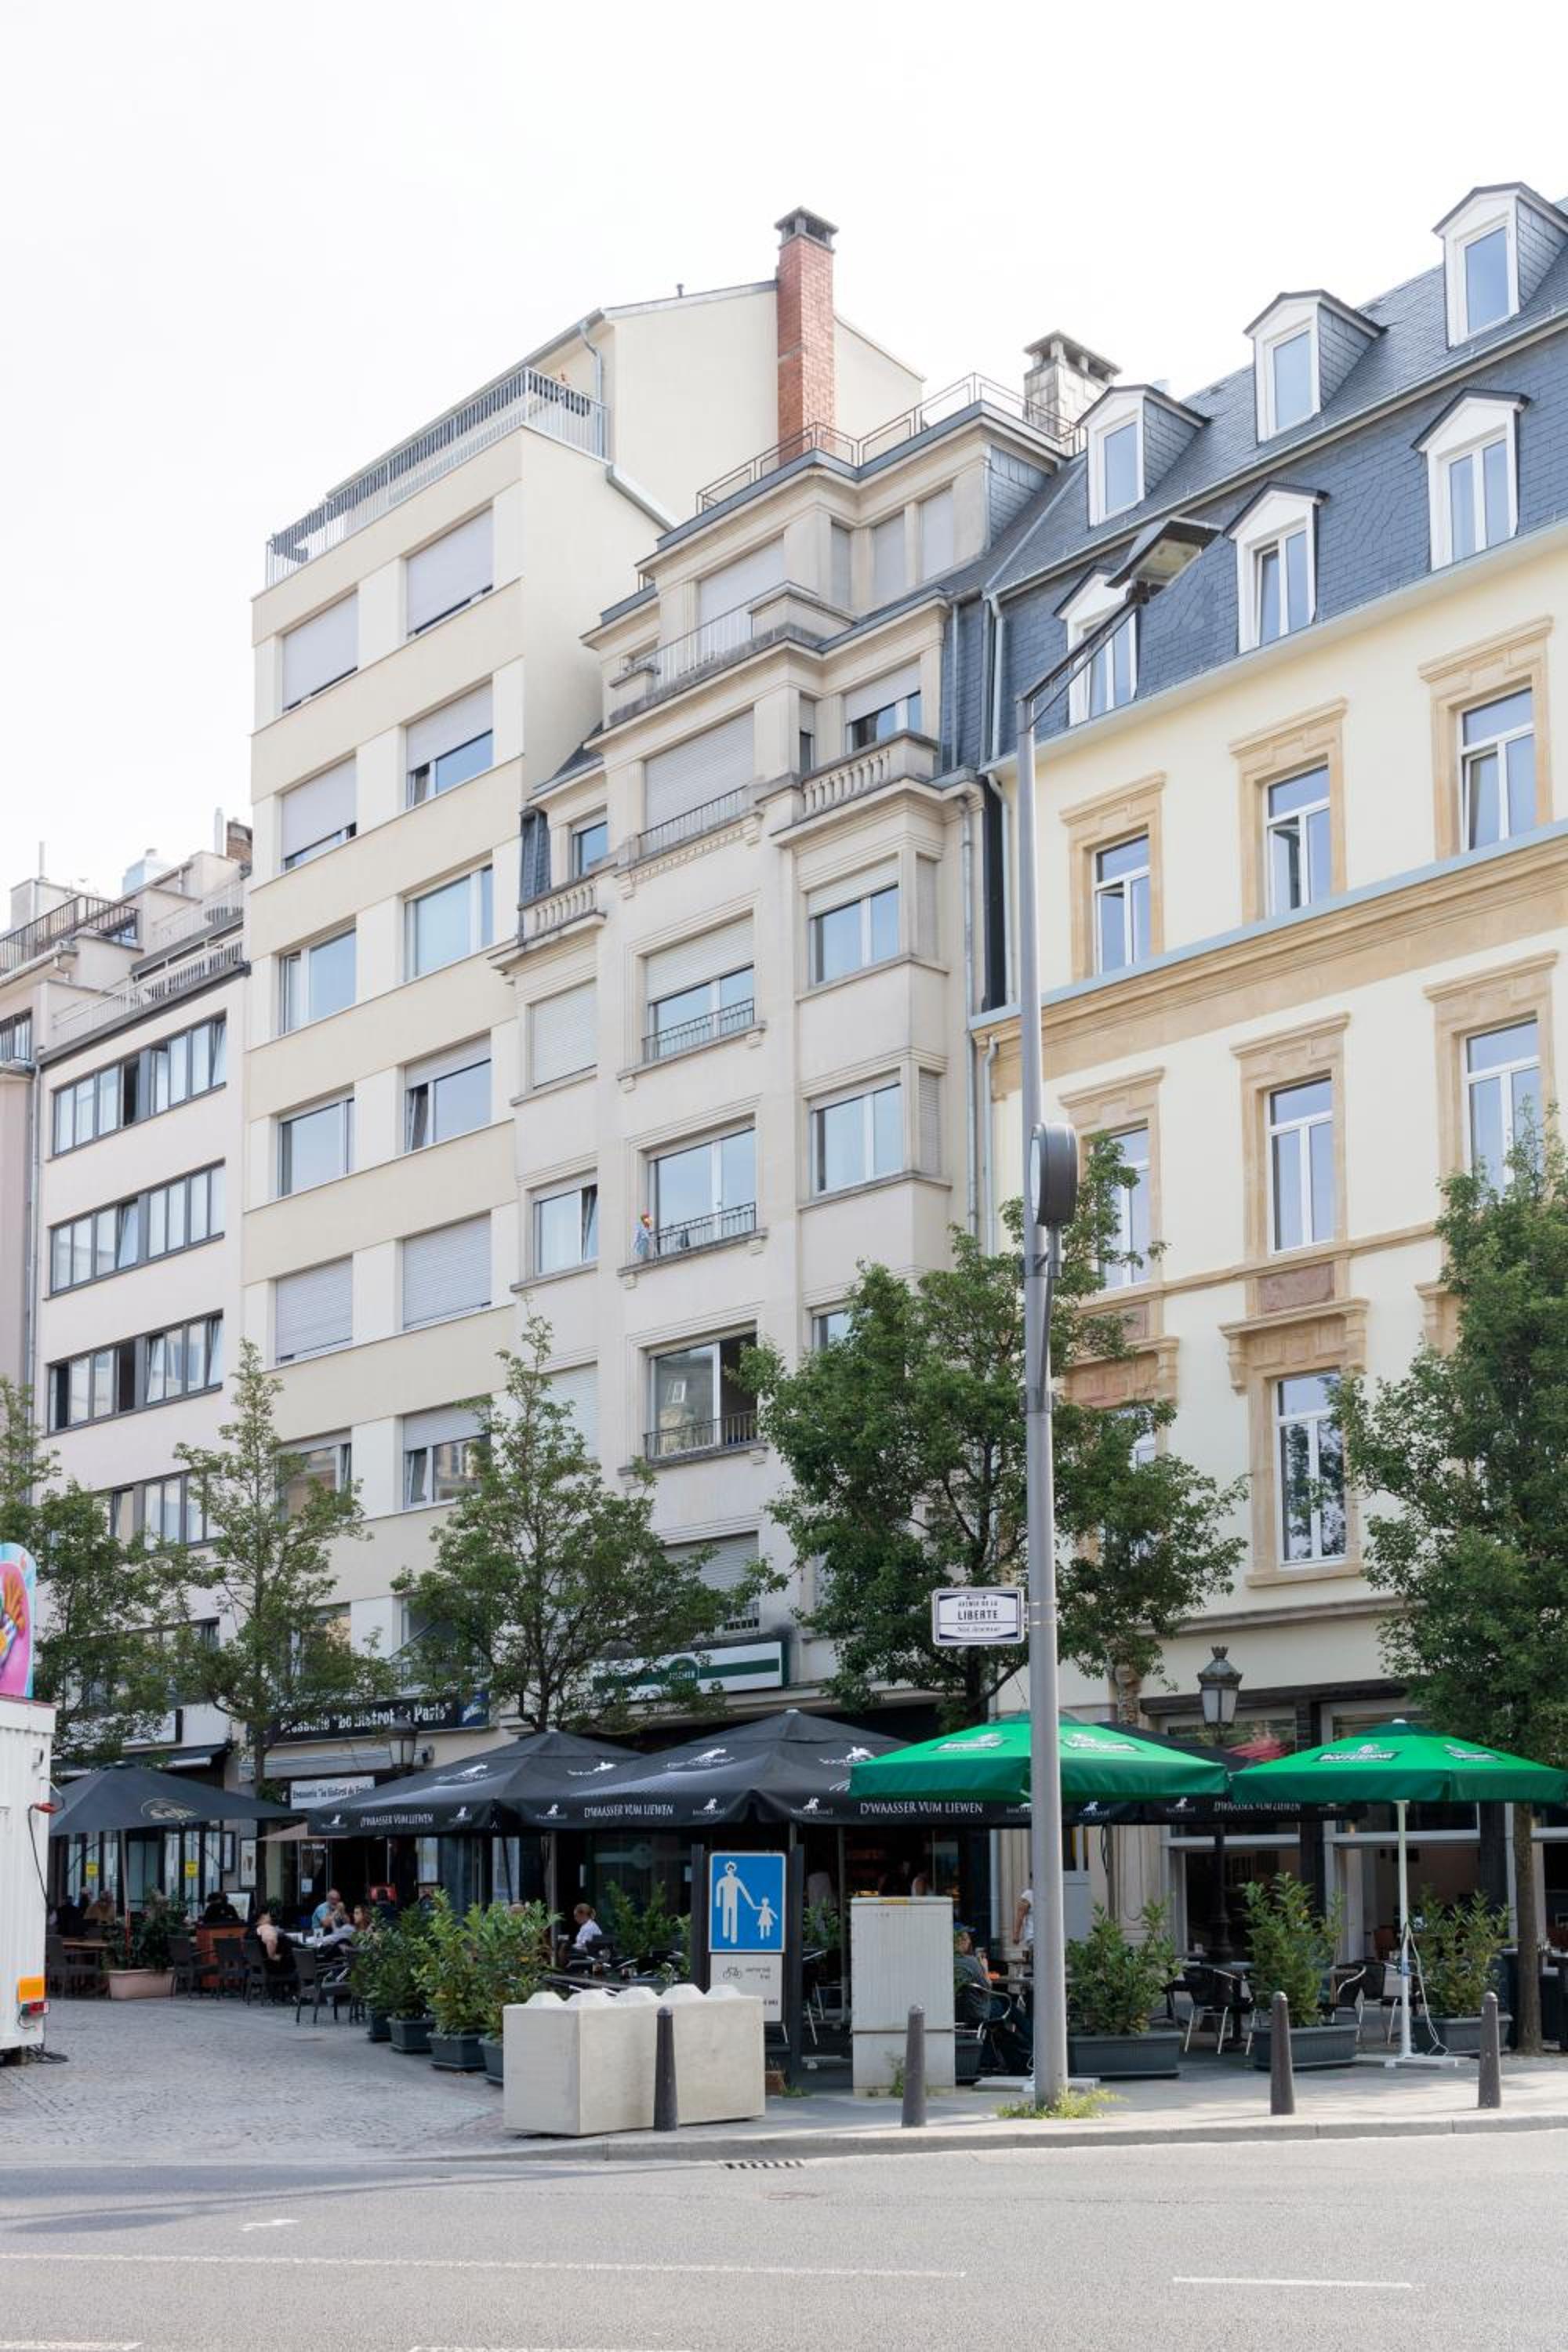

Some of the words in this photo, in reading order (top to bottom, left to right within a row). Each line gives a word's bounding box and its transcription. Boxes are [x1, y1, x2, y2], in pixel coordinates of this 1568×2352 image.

[958, 1610, 998, 1621] LIBERTE
[860, 1802, 916, 1814] D'WAASSER
[919, 1802, 942, 1813] VUM
[945, 1802, 983, 1813] LIEWEN
